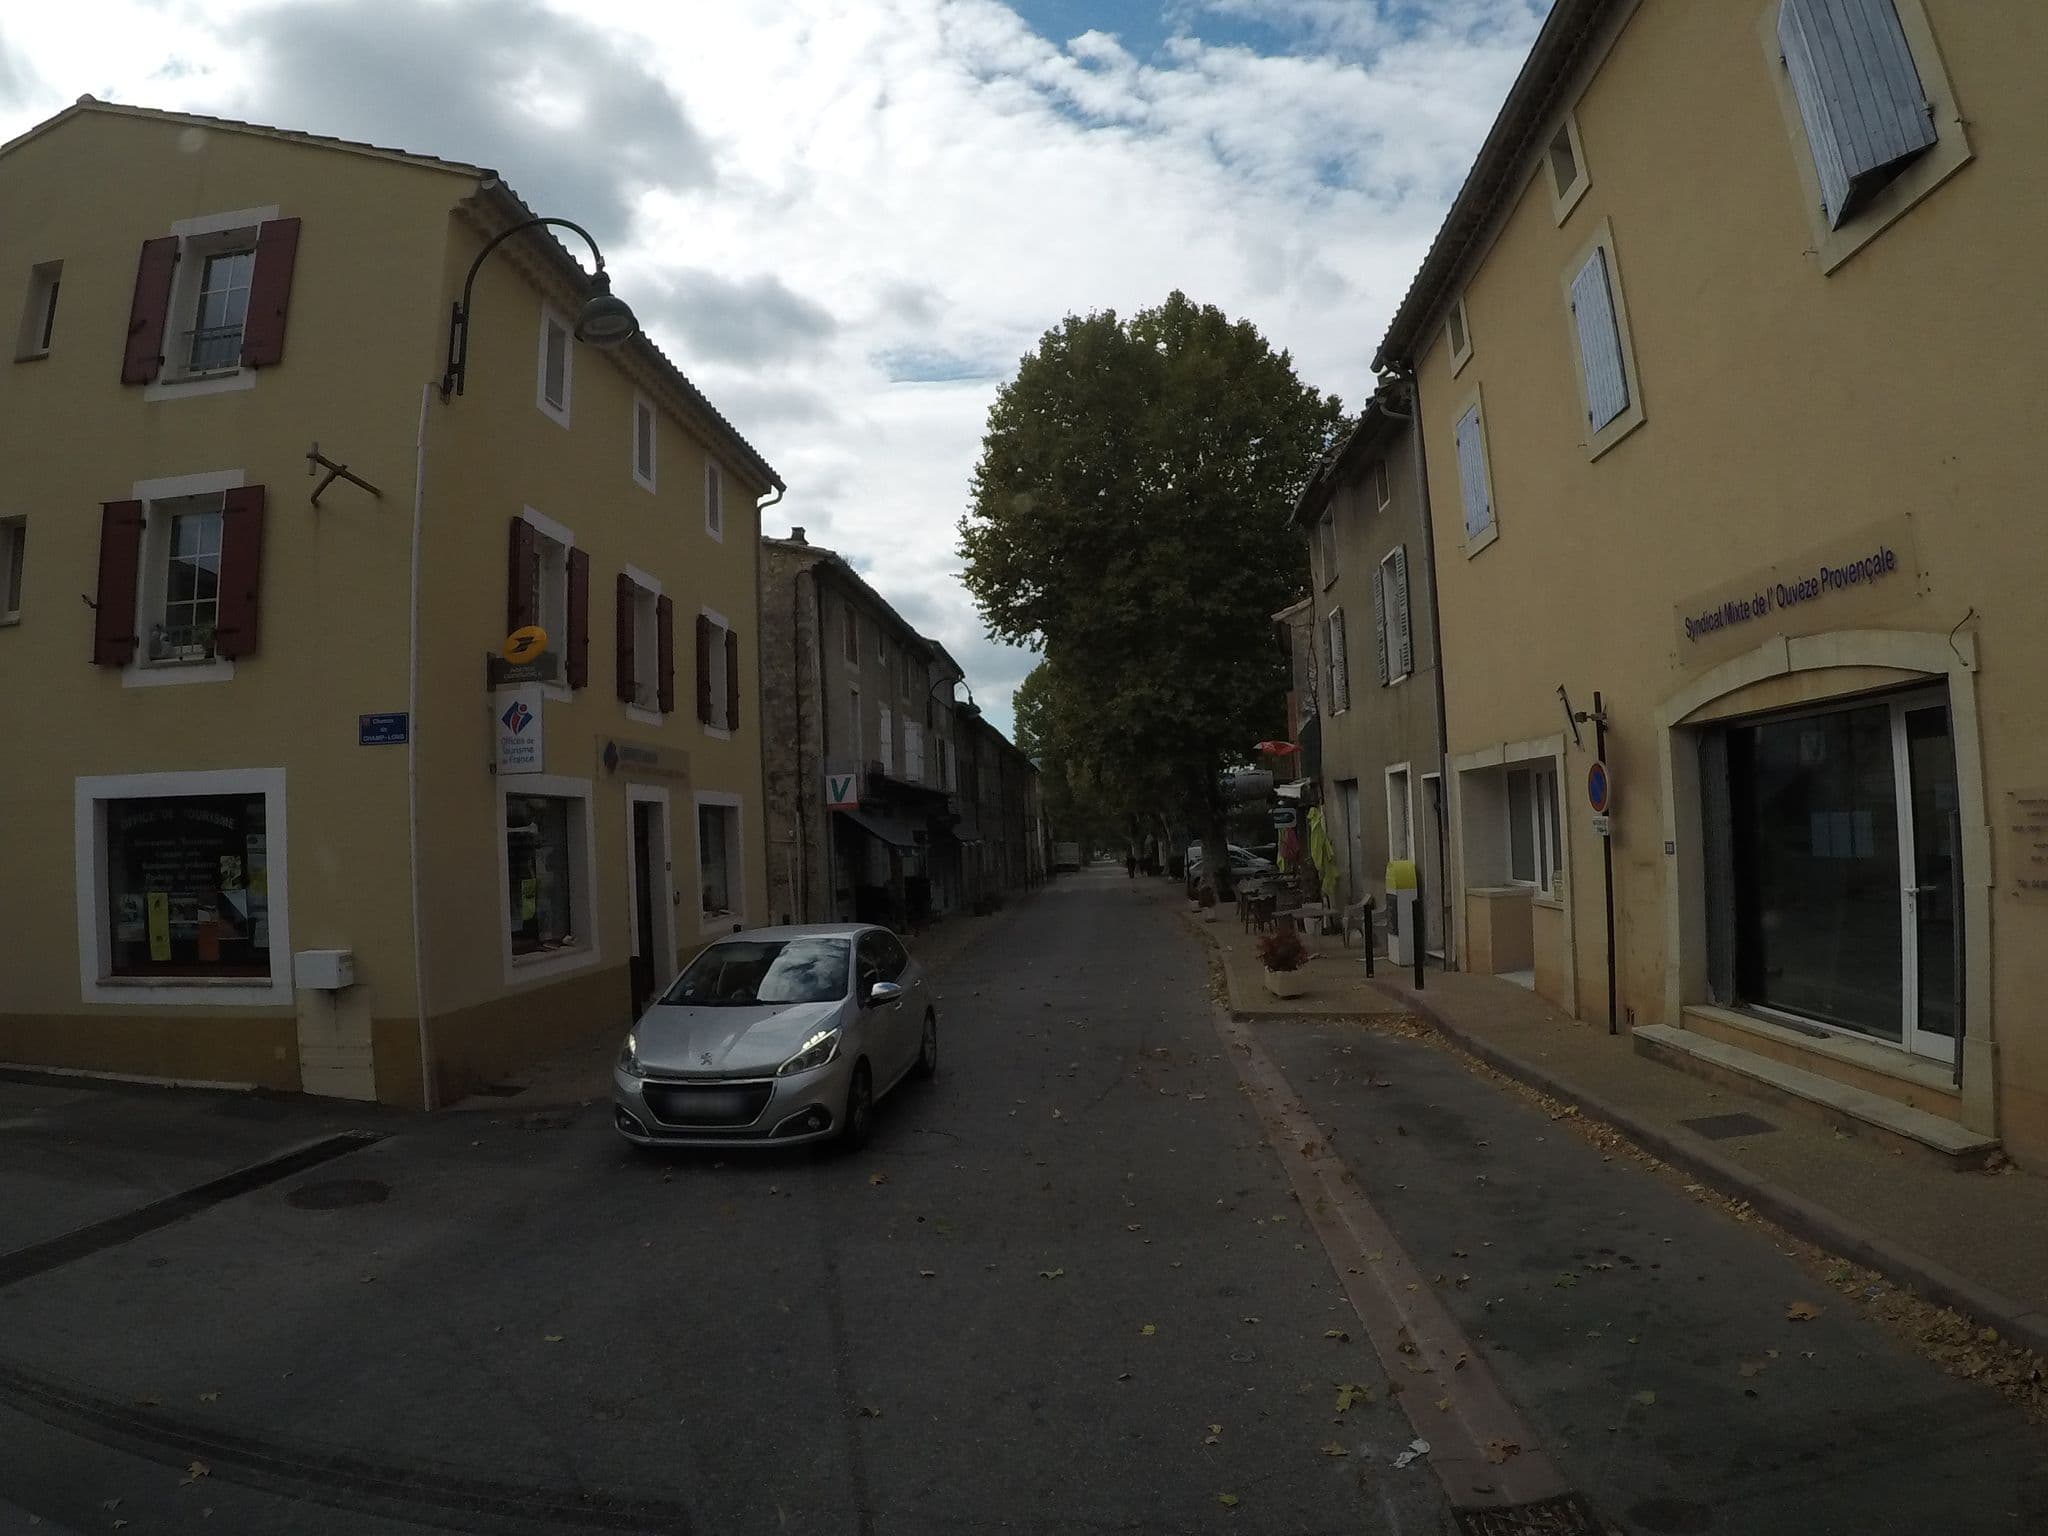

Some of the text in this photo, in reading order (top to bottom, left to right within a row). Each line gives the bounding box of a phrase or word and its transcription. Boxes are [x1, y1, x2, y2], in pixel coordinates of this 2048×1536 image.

[1684, 607, 1723, 642] Syndicat
[1724, 597, 1751, 626] Mixte
[1752, 593, 1767, 616] de
[1776, 575, 1818, 607] Ouvèze
[1820, 546, 1897, 594] Provençale
[527, 736, 536, 744] de
[502, 745, 536, 755] Tourisme
[509, 754, 536, 767] France
[831, 777, 851, 802] V
